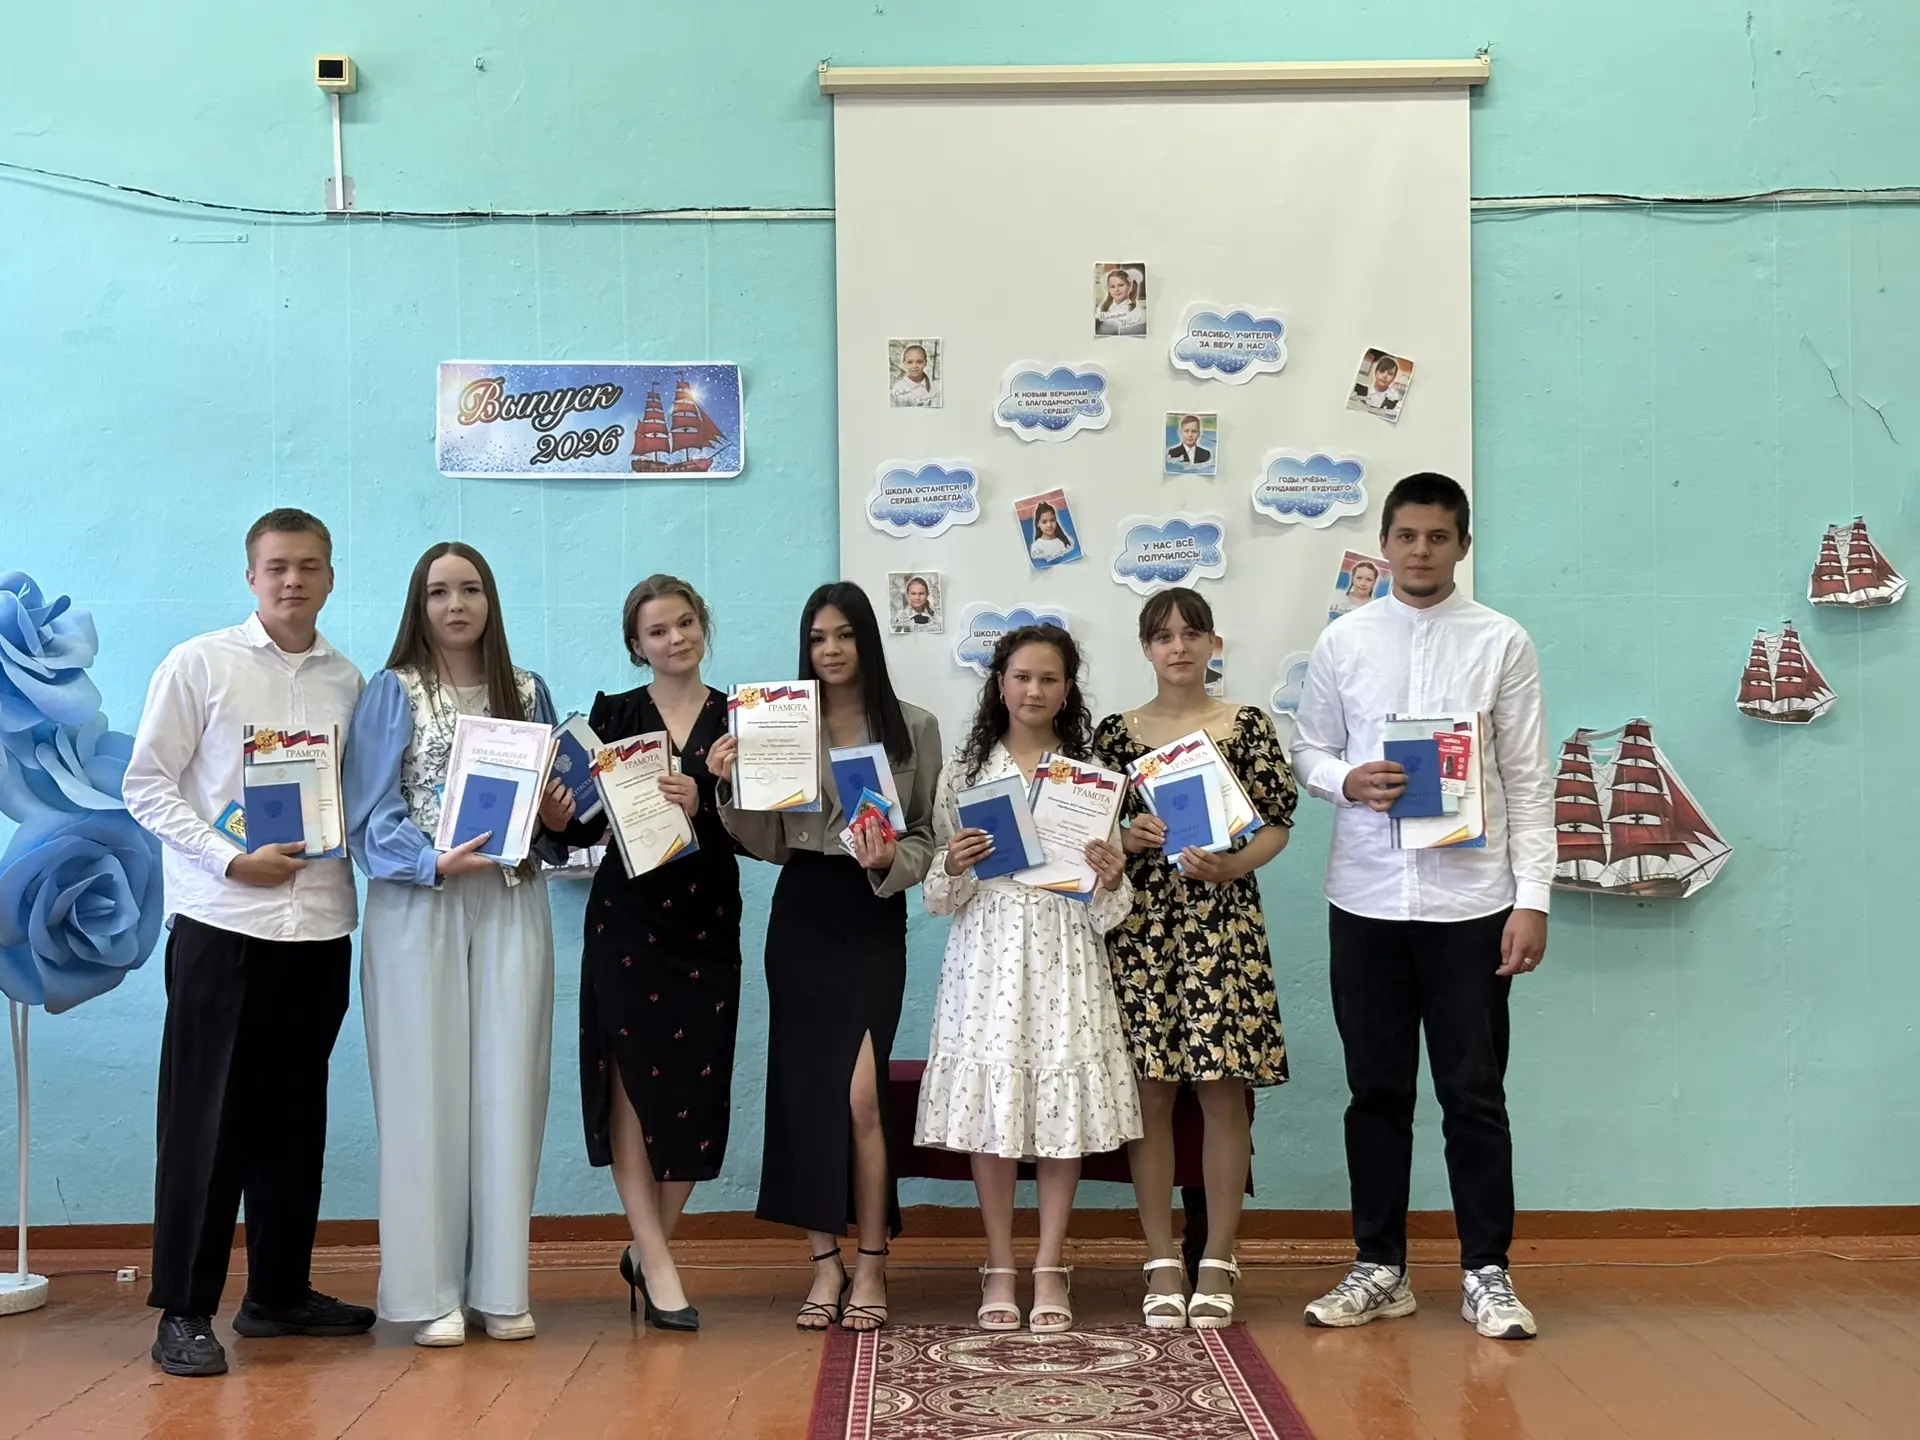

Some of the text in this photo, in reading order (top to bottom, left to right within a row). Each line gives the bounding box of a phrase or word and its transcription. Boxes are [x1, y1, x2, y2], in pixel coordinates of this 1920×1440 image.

[1191, 330, 1232, 339] СПАСИБО,
[1246, 342, 1266, 350] НАС!
[458, 376, 624, 432] Выпуск
[1025, 398, 1089, 407] БЛАГОДАРНОСТЬЮ
[530, 424, 625, 465] 2026
[1302, 475, 1327, 483] УЧЁБЫ
[885, 487, 913, 496] ШКОЛА
[915, 484, 960, 494] ОСТАНЕТСЯ
[890, 493, 964, 505] СЕРДЦЕ НАВСЕГДА!
[1143, 537, 1195, 551] У НАС ВСЁ
[1137, 549, 1201, 563] ПОЛУЧИЛОСЬ!
[973, 630, 1002, 638] ШКОЛА
[768, 703, 808, 712] ГРАМОТА
[286, 749, 327, 758] ГРАМОТА
[624, 753, 661, 770] ГРАМОТА
[1171, 751, 1208, 771] ГРАМОТА
[1072, 786, 1111, 803] ГРАМОТА
